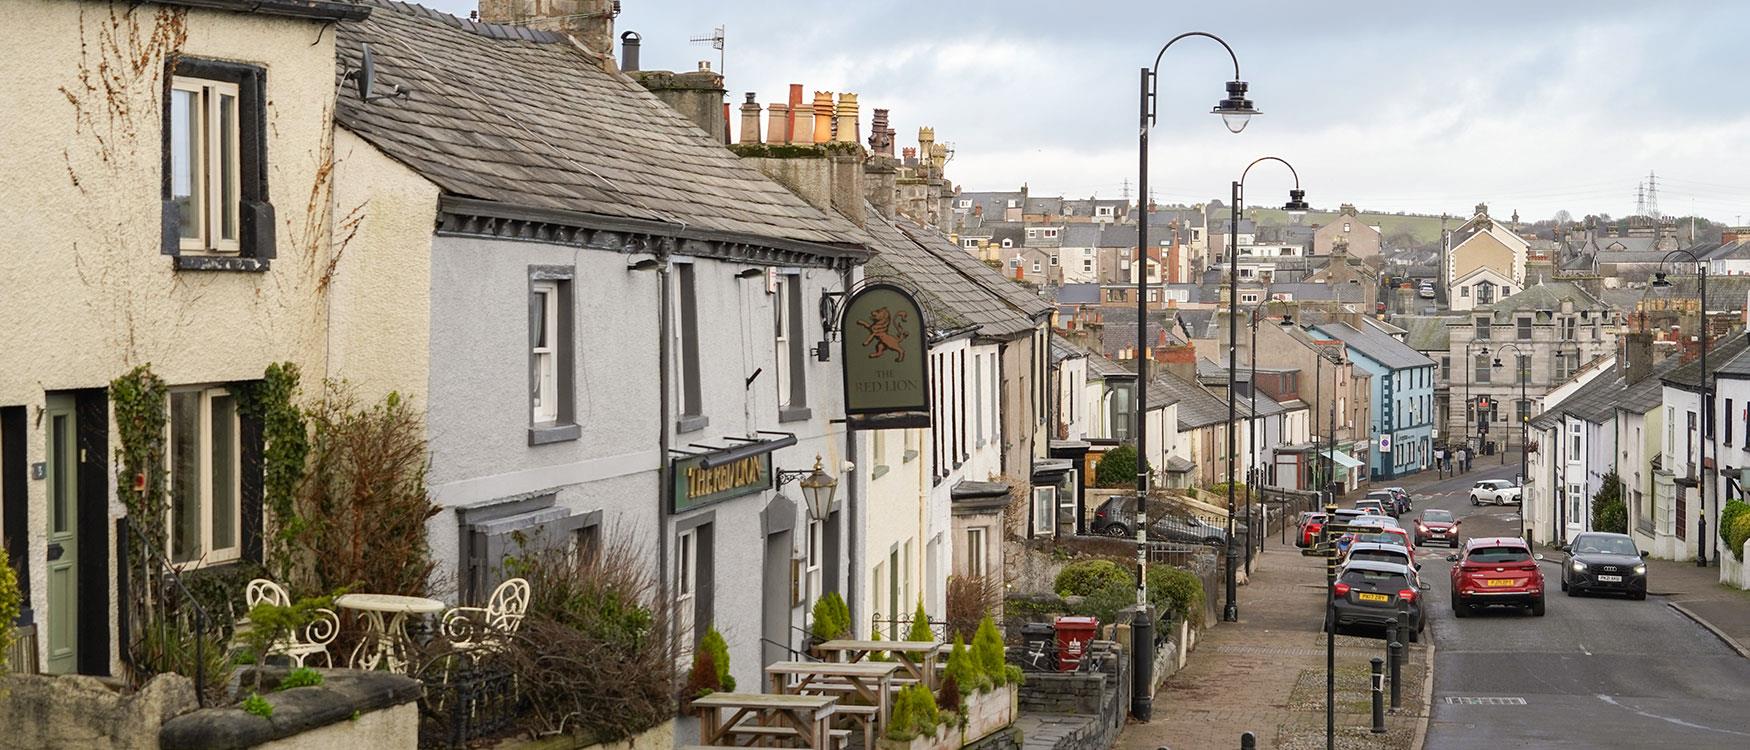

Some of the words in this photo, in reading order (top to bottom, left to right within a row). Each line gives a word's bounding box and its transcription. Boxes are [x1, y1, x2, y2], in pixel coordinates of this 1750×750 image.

[875, 368, 895, 379] THE
[855, 380, 882, 393] RED
[885, 379, 917, 393] LION
[687, 466, 713, 498] THE
[713, 461, 735, 493] RED
[735, 455, 761, 488] LION
[1028, 640, 1045, 666] 7
